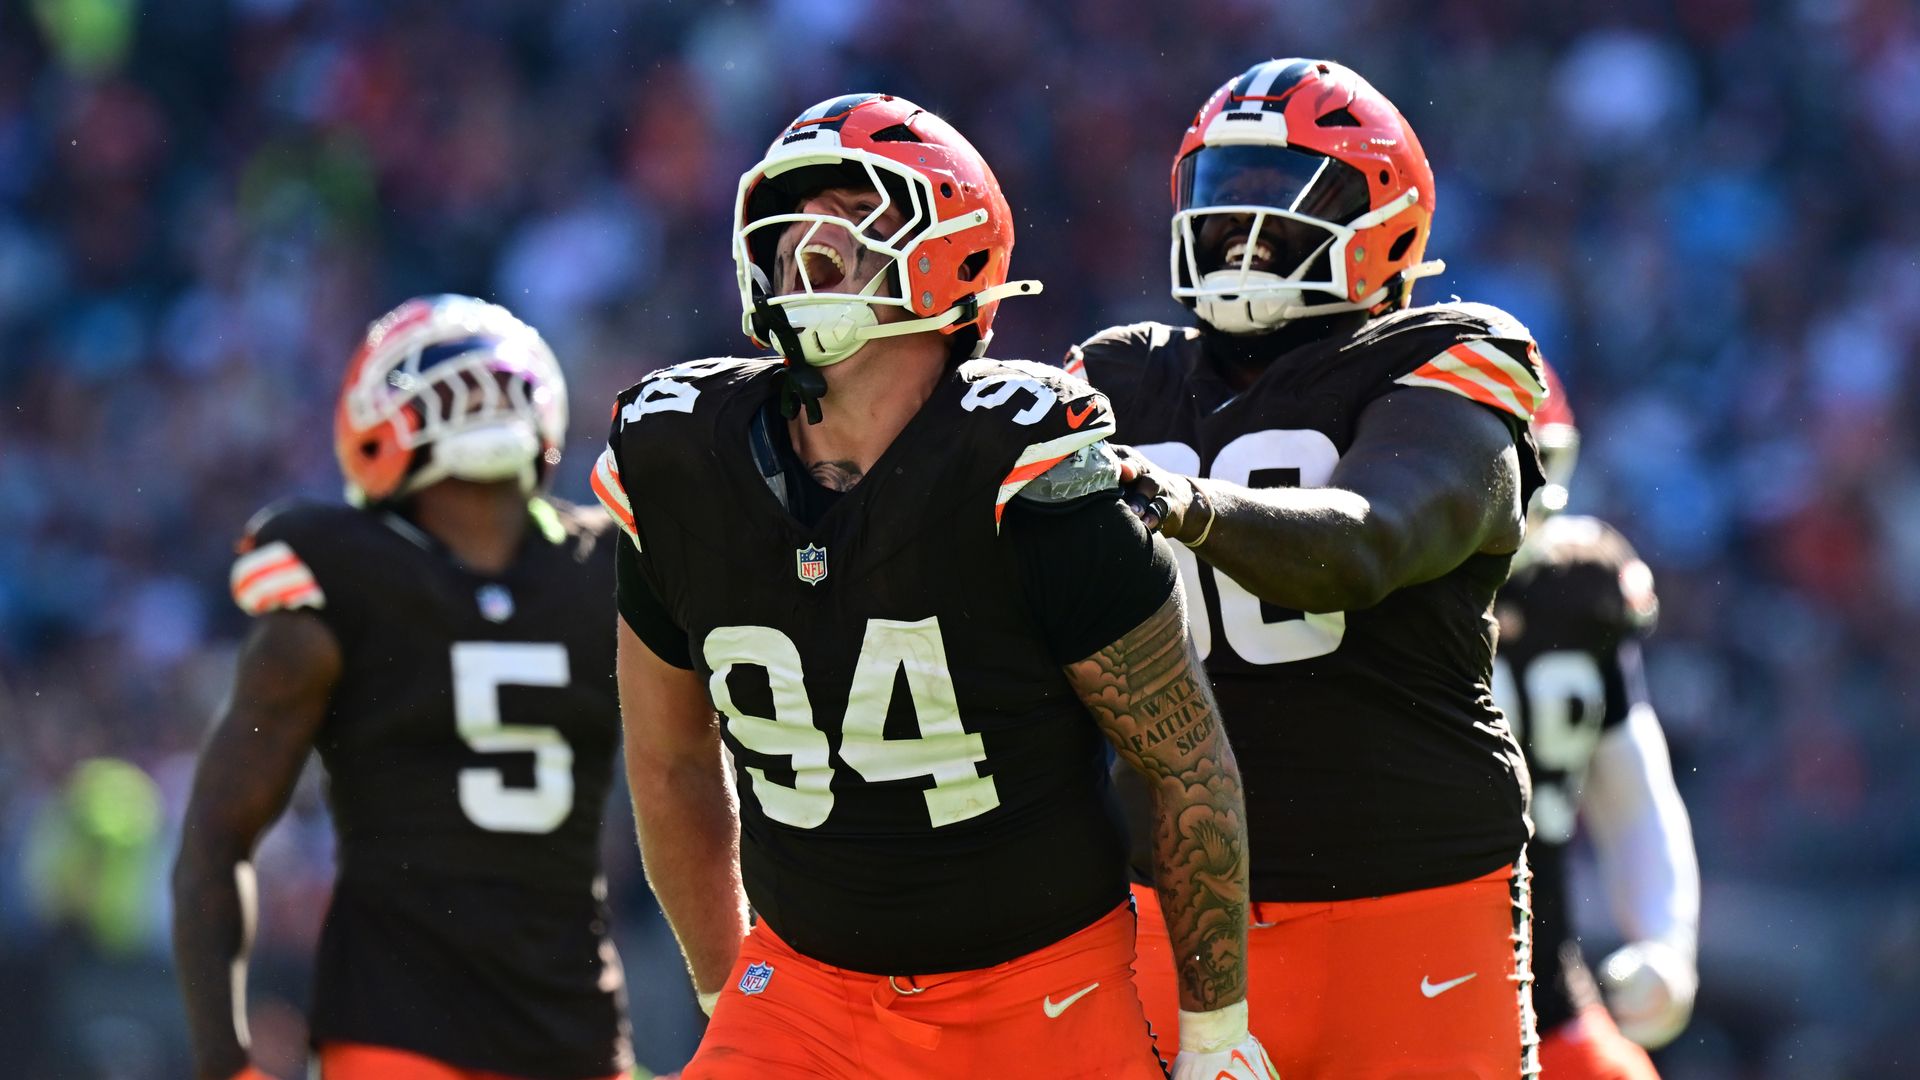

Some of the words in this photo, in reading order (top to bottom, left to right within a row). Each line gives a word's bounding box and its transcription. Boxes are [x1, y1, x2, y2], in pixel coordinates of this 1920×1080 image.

[802, 562, 824, 578] NFL
[450, 641, 574, 833] 5
[703, 616, 1000, 829] 94
[1141, 672, 1199, 718] WALK
